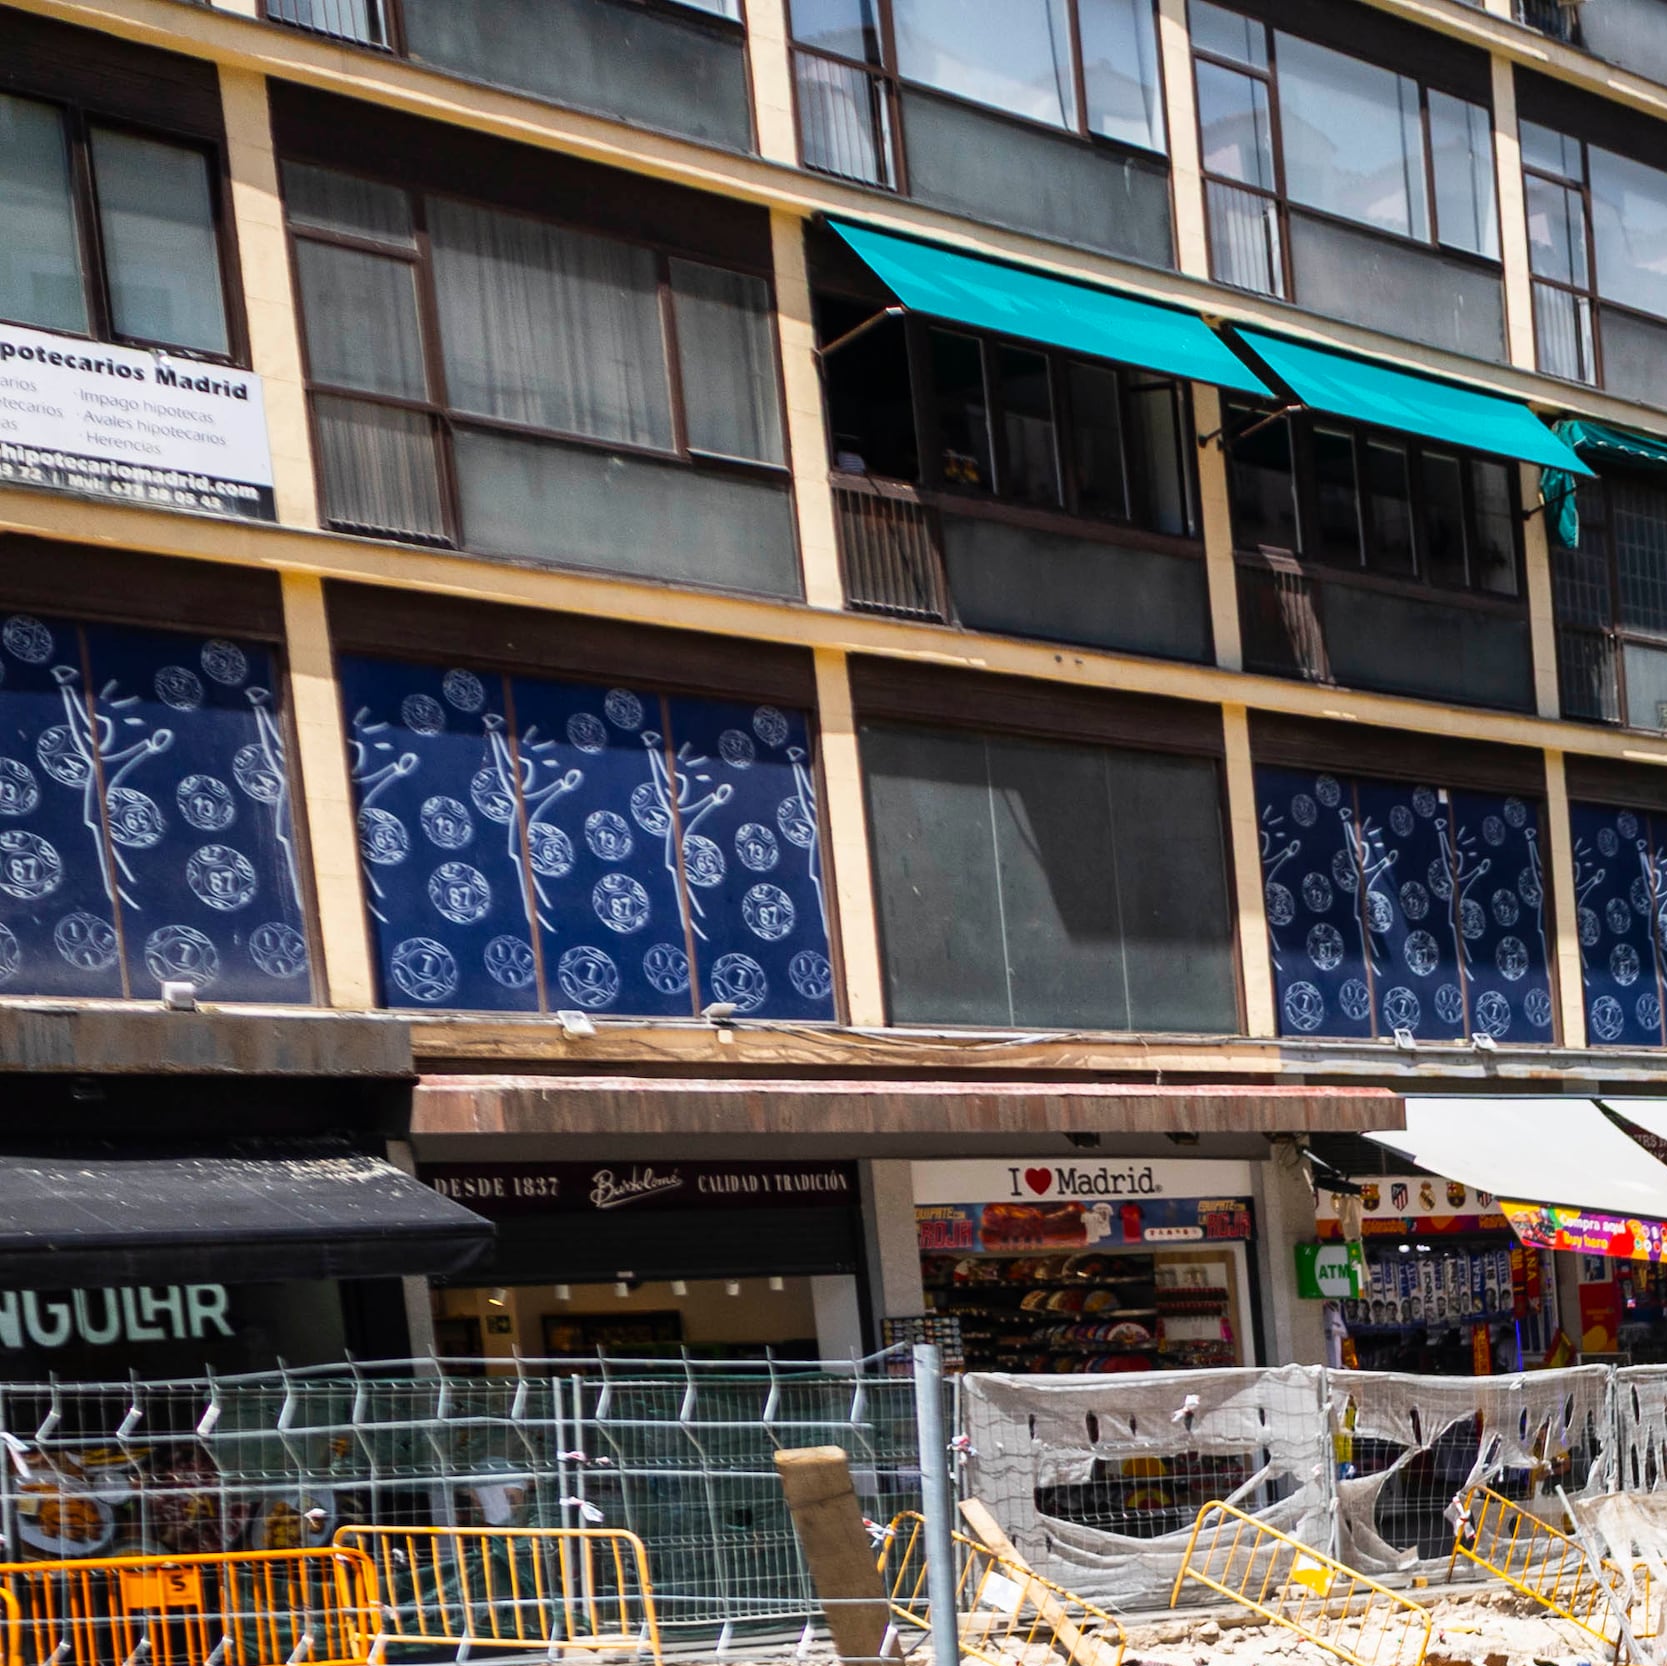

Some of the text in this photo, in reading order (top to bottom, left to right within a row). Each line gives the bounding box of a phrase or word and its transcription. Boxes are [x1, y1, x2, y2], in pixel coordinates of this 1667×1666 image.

[155, 366, 248, 400] Madrid
[80, 389, 139, 411] Impago
[144, 400, 215, 424] hipotecas
[84, 410, 133, 431] Avales
[138, 418, 226, 446] hipotecarios
[87, 432, 162, 455] Herencias
[434, 1177, 505, 1197] DESDE
[513, 1177, 560, 1196] 1837
[698, 1174, 758, 1192] CALIDAD
[762, 1174, 772, 1191] Y
[775, 1169, 848, 1192] TRADICIÓN
[1008, 1167, 1155, 1196] I Madrid
[920, 1220, 973, 1248] ROJA
[1560, 1214, 1600, 1232] Compra
[1563, 1231, 1608, 1249] Buy here
[1318, 1263, 1350, 1280] ATM
